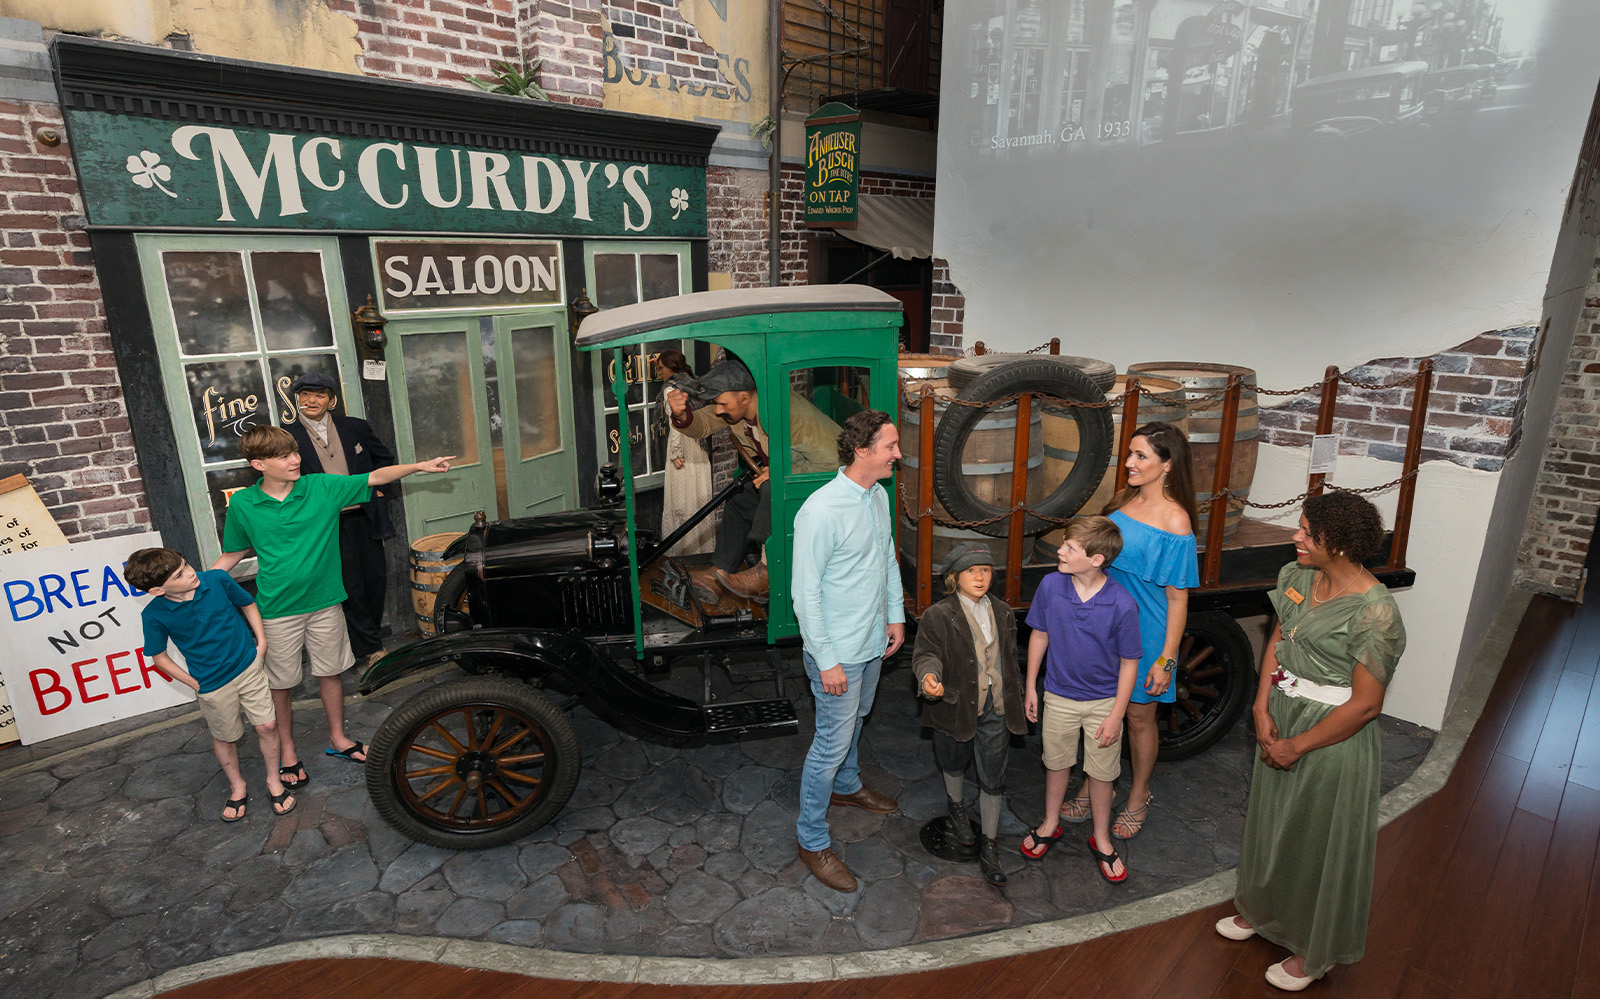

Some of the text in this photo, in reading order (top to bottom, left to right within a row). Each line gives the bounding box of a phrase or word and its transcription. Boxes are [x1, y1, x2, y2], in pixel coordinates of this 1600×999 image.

[807, 131, 857, 168] ANHEUSER
[991, 121, 1130, 149] Savannah, GA 1933
[812, 151, 854, 187] BUSCH
[809, 190, 851, 203] ON TAP
[384, 255, 557, 298] SALOON
[203, 386, 259, 448] fine
[18, 527, 32, 539] of
[20, 540, 39, 552] for
[47, 606, 121, 655] NOT
